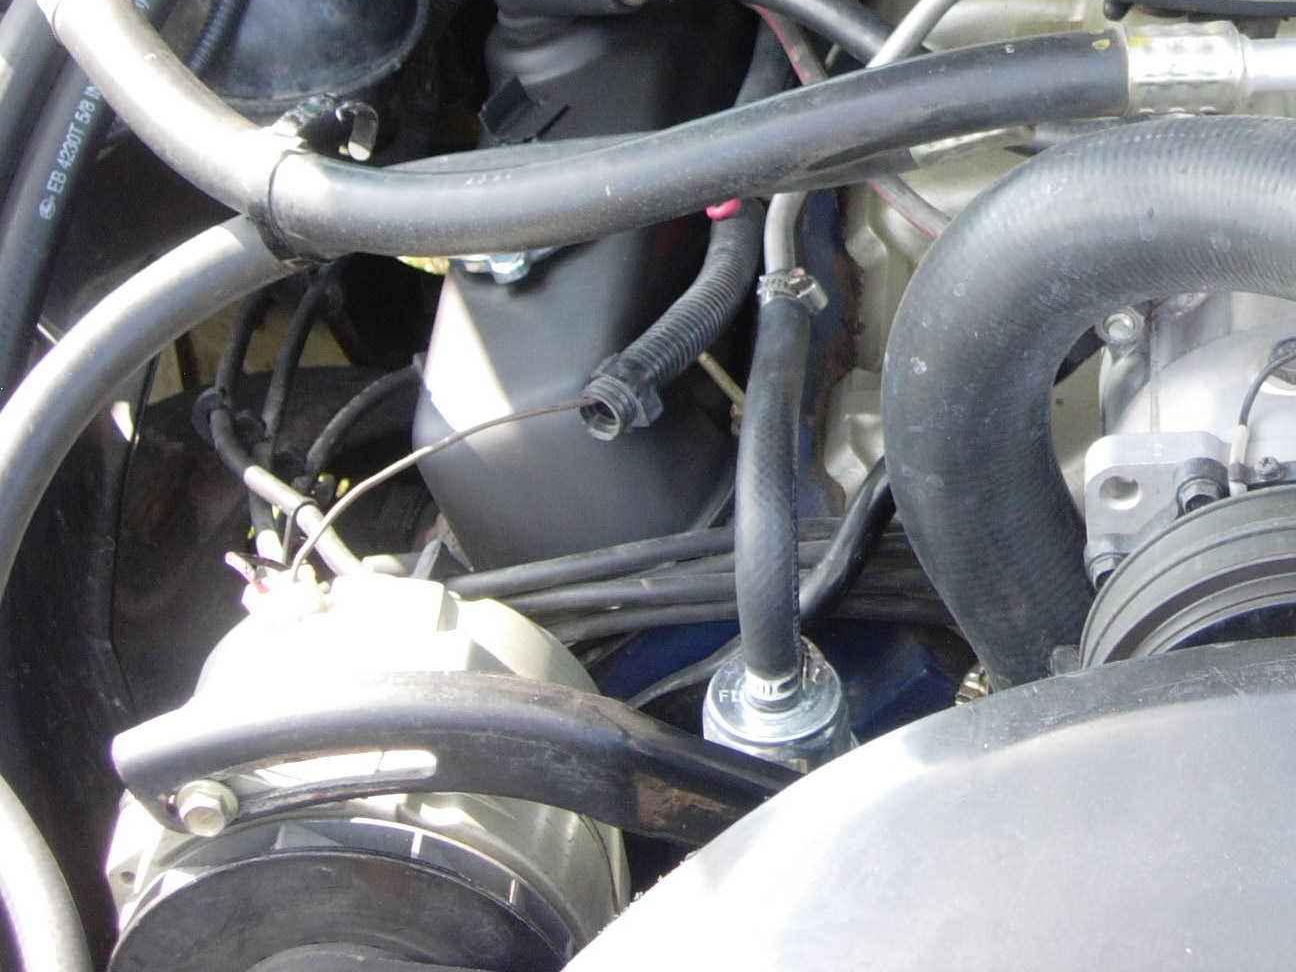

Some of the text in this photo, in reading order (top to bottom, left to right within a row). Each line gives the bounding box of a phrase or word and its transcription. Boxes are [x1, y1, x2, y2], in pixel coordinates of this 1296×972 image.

[47, 170, 67, 194] EB
[57, 122, 85, 169] 4230T
[75, 99, 96, 125] 5/8
